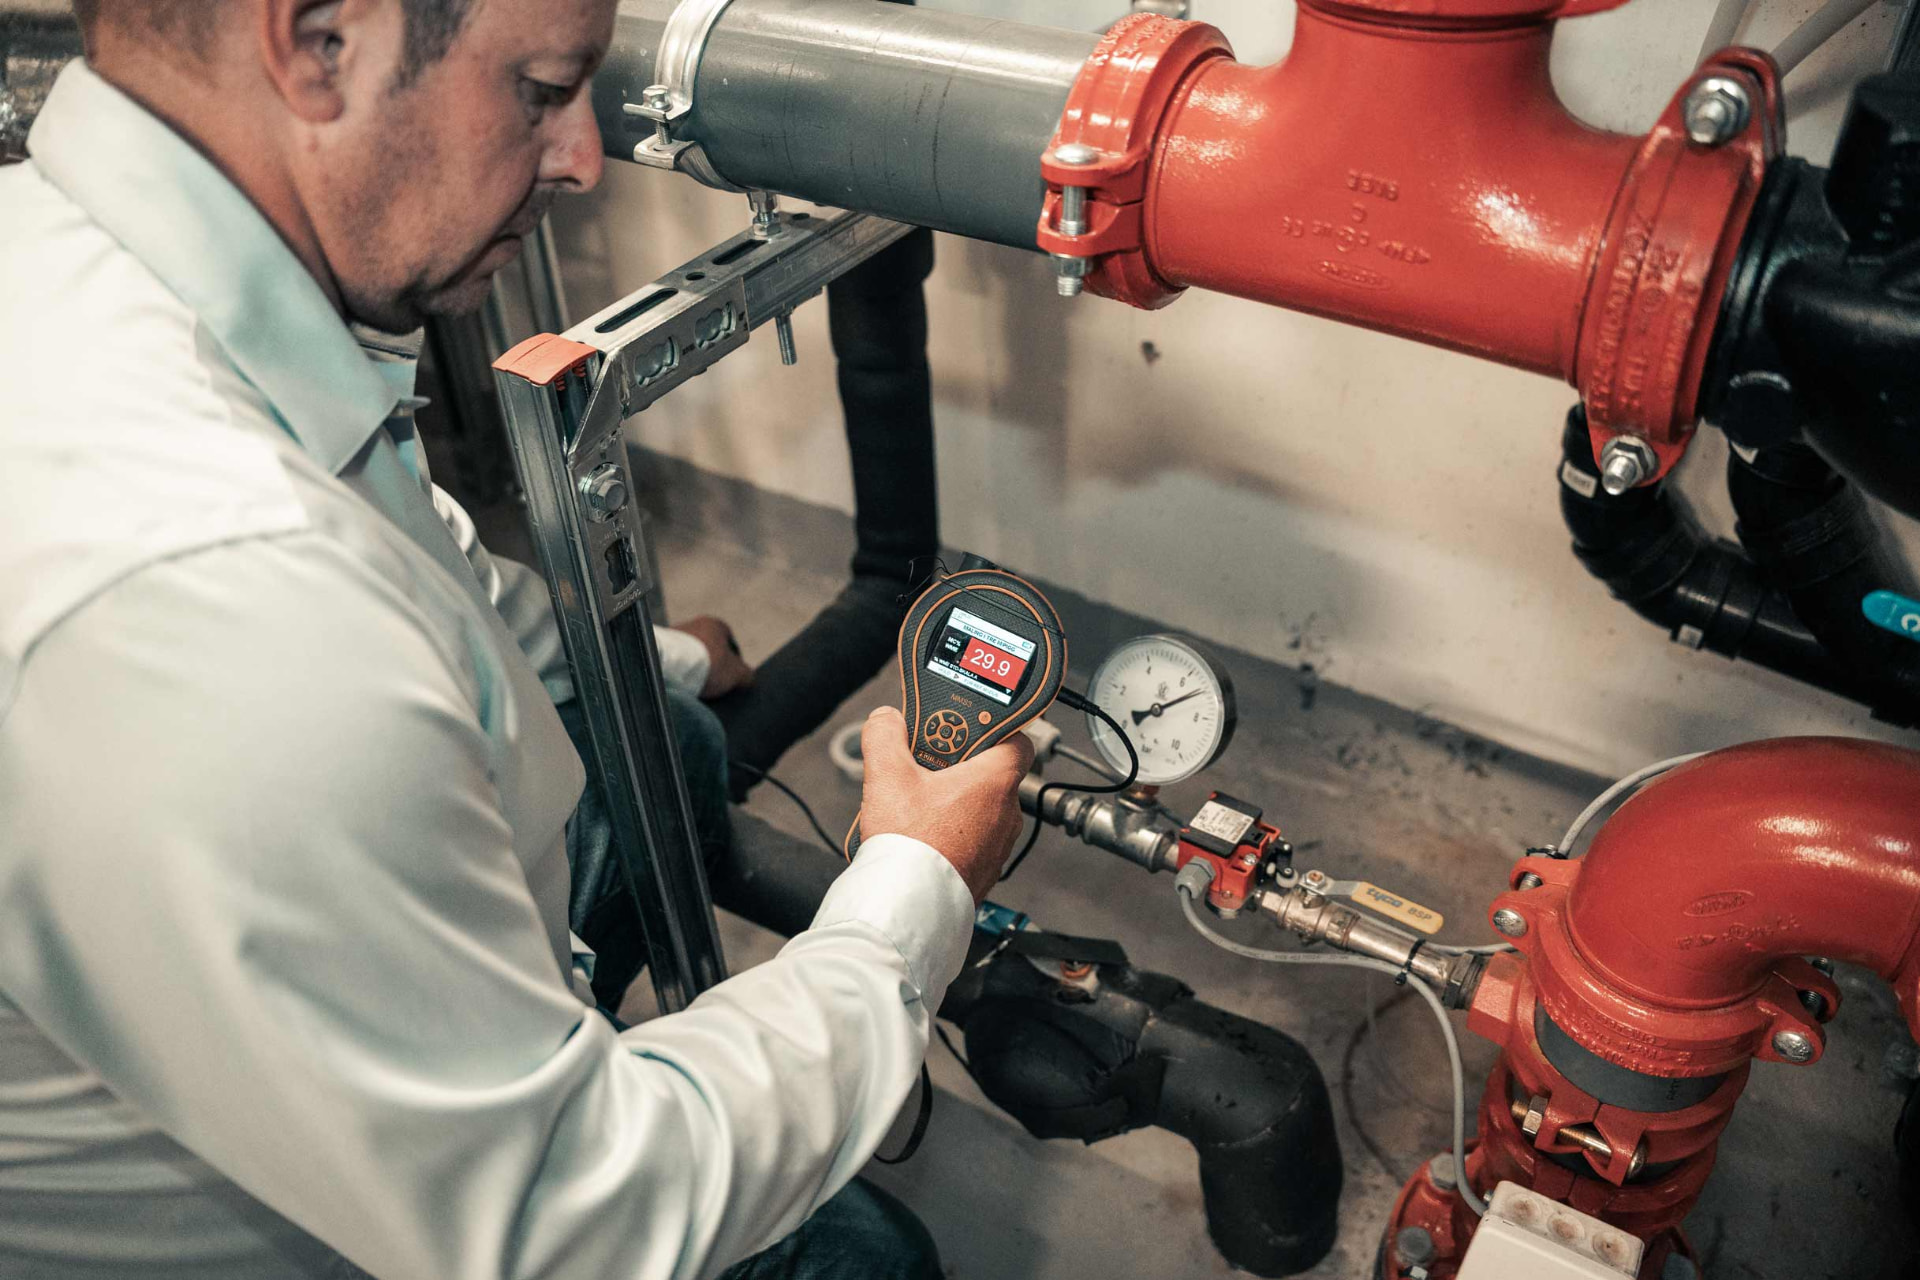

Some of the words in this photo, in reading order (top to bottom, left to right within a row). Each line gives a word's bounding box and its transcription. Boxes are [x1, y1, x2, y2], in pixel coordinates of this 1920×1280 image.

[970, 648, 1011, 677] 29.9
[1180, 677, 1186, 688] 6
[1171, 738, 1181, 750] 10
[1366, 887, 1403, 908] tyco
